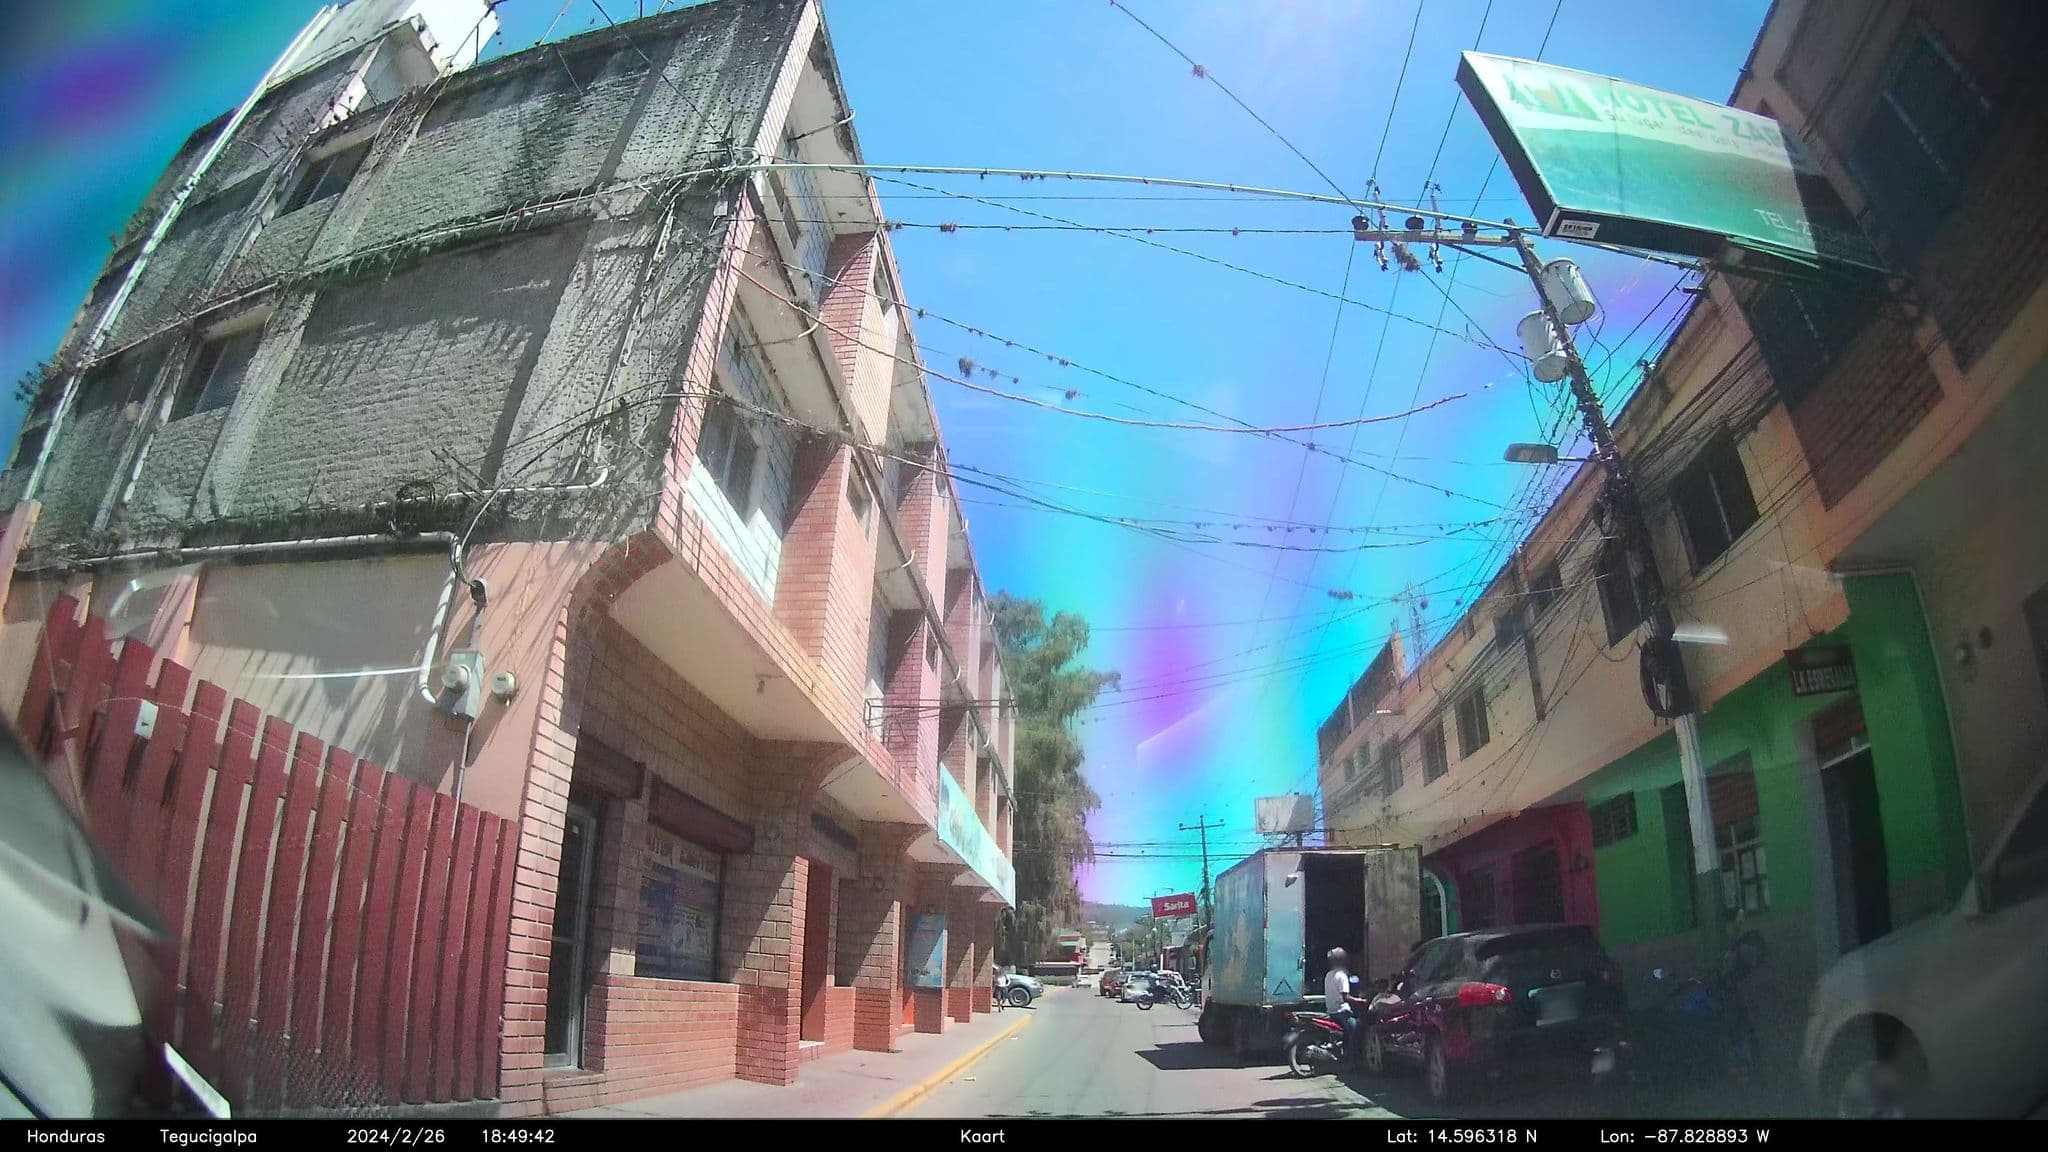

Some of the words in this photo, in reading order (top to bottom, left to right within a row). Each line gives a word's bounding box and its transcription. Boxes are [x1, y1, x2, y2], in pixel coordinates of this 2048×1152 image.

[1595, 84, 1716, 130] HOTEL
[1754, 208, 1798, 233] TEL
[1163, 900, 1190, 911] Sarita
